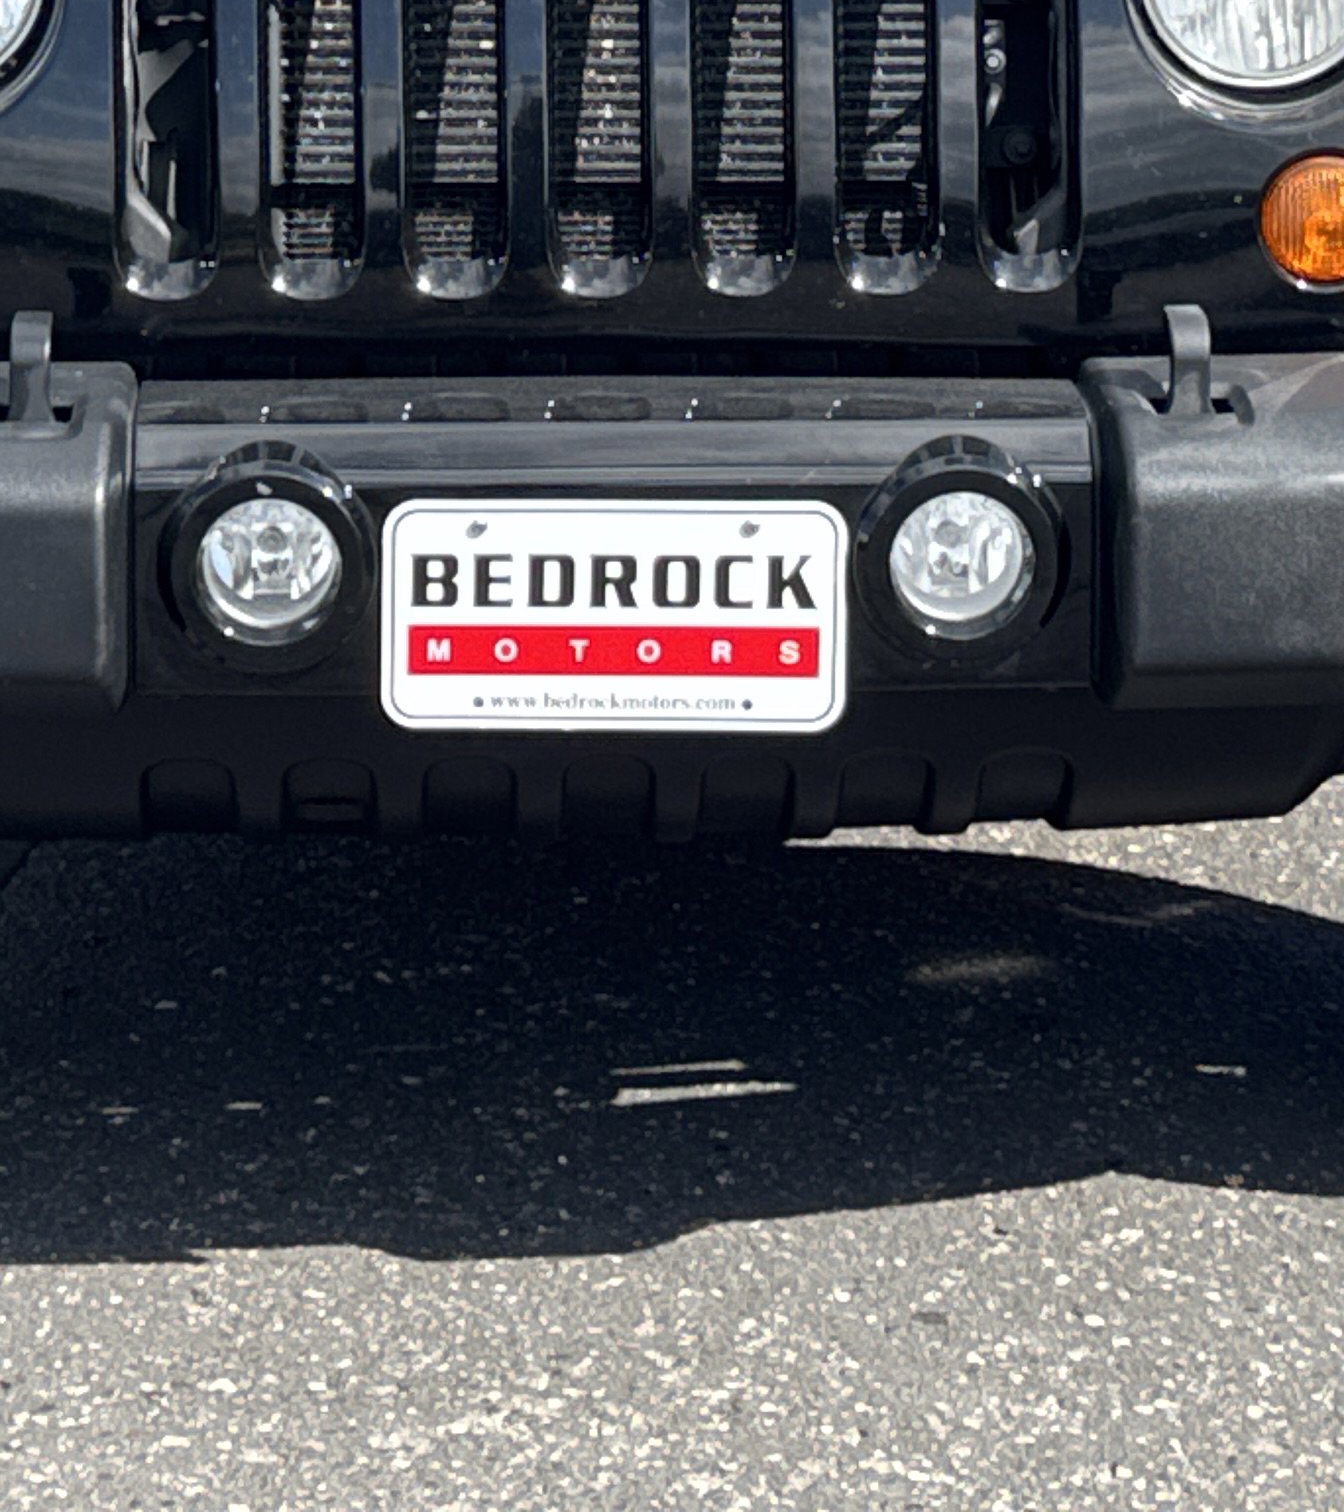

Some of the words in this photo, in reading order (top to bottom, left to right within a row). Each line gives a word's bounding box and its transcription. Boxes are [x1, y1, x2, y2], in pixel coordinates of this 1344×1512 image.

[410, 553, 818, 610] BEDROCK
[426, 637, 802, 666] MOTORS
[490, 692, 737, 712] www.bedrockmotors.com
